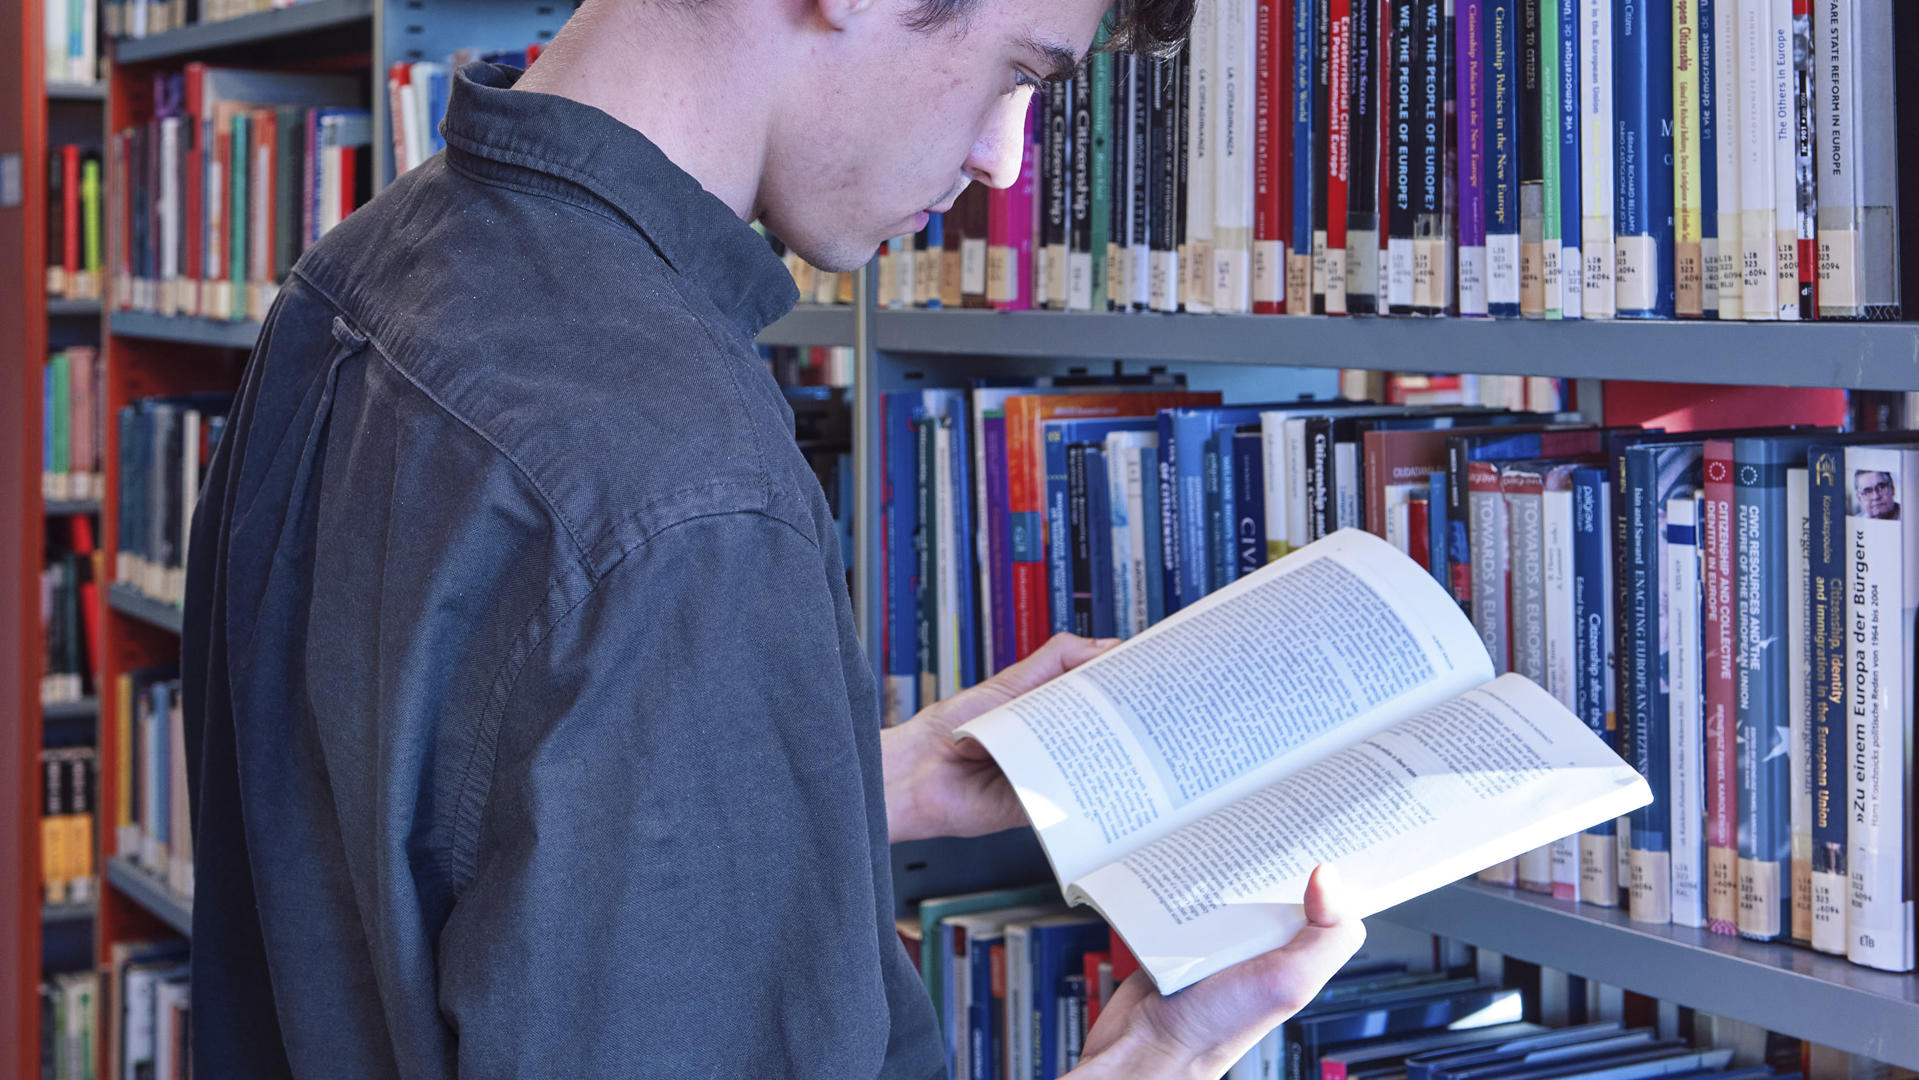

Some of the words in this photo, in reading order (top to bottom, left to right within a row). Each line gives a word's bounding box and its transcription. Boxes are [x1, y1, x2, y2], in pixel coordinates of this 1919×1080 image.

[1332, 22, 1341, 33] in
[1399, 5, 1410, 32] WE,
[1426, 4, 1437, 31] WE,
[1591, 8, 1601, 17] in
[1591, 20, 1601, 36] the
[1624, 5, 1635, 36] Citizens
[1700, 16, 1709, 28] de
[1258, 5, 1269, 77] CITIZENSHIP
[1322, 35, 1329, 44] in
[1468, 4, 1479, 58] Citizenship
[1494, 7, 1506, 70] Citizenship
[1525, 32, 1535, 45] TO
[1562, 24, 1571, 37] de
[1830, 28, 1841, 61] STATE
[1300, 45, 1308, 60] the
[1340, 16, 1350, 109] Extraterritorial
[1399, 36, 1410, 62] THE
[1426, 36, 1437, 62] THE
[1590, 39, 1601, 83] European
[1676, 27, 1692, 71] Citizenship
[1775, 29, 1787, 66] Europe
[1300, 63, 1309, 88] Arab
[1321, 62, 1330, 85] West
[1331, 36, 1341, 130] Postcommunist
[1469, 61, 1480, 95] Policies
[1525, 48, 1535, 90] CITIZENS
[1562, 40, 1574, 113] démocratique
[1700, 33, 1712, 106] démocratique
[1776, 69, 1786, 79] in
[1398, 66, 1410, 120] PEOPLE
[1425, 66, 1437, 120] PEOPLE
[1470, 98, 1480, 108] in
[1496, 74, 1507, 114] Policies
[1592, 86, 1601, 114] Union
[1776, 82, 1788, 118] Others
[1831, 65, 1842, 111] REFORM
[1226, 83, 1236, 157] CITTADINANZA
[1299, 91, 1308, 122] World
[1470, 110, 1480, 125] the
[1701, 111, 1710, 126] vie
[1832, 114, 1842, 126] IN
[1398, 124, 1409, 142] OF
[1425, 124, 1436, 142] OF
[1497, 118, 1507, 130] in
[1564, 115, 1573, 130] vie
[1619, 121, 1627, 144] DARIO
[1701, 128, 1710, 139] La
[1777, 122, 1788, 140] The
[1338, 113, 1349, 181] Citizenship
[1470, 128, 1479, 150] New
[1497, 133, 1507, 151] the
[1565, 134, 1573, 144] La
[1832, 130, 1843, 176] EUROPE
[1050, 115, 1065, 225] Citizenship
[1073, 109, 1090, 220] Citizenship
[1258, 118, 1269, 193] ORIENTALISM
[1329, 134, 1340, 176] Europe
[1470, 154, 1480, 187] Europe
[1497, 154, 1507, 180] New
[1619, 146, 1627, 194] CASTIGLIONE
[1398, 147, 1409, 210] EUROPE?
[1424, 147, 1436, 210] EUROPE?
[1627, 165, 1635, 197] RICHARD
[1495, 184, 1507, 224] Europe
[1744, 269, 1767, 277] .6094
[1314, 434, 1327, 509] Citizenship
[1583, 486, 1595, 533] palgrave
[1634, 488, 1645, 506] Isin
[1634, 508, 1645, 526] and
[1707, 501, 1717, 553] IDENTITY
[1739, 505, 1748, 552] FUTURE
[1749, 505, 1760, 537] CIVIC
[1822, 496, 1833, 564] Kostakopoulou
[1480, 497, 1496, 583] TOWARDS
[1526, 500, 1540, 583] TOWARDS
[1634, 529, 1646, 564] Saward
[1719, 501, 1730, 575] CITIZENSHIP
[1708, 557, 1717, 569] IN
[1740, 555, 1748, 570] OF
[1749, 540, 1760, 614] RESOURCES
[1853, 530, 1868, 605] Bürger«
[1485, 584, 1496, 597] A
[1527, 587, 1539, 600] A
[1708, 572, 1718, 621] EUROPE
[1720, 578, 1731, 603] AND
[1740, 575, 1748, 596] THE
[1816, 577, 1828, 600] and
[1871, 585, 1880, 607] 2004
[1635, 570, 1647, 638] ENACTING
[1828, 578, 1843, 650] Citizenship,
[1871, 609, 1880, 622] bis
[1720, 606, 1732, 680] COLLECTIVE
[1740, 601, 1749, 667] EUROPEAN
[1750, 617, 1761, 642] AND
[1815, 604, 1828, 682] immigration
[1853, 612, 1865, 643] der
[1871, 625, 1880, 646] 1964
[1588, 614, 1601, 676] Citizenship
[1750, 648, 1761, 671] THE
[1872, 649, 1880, 667] von
[1590, 678, 1602, 704] after
[1636, 641, 1648, 711] EUROPEAN
[1740, 670, 1749, 710] UNION
[1828, 654, 1843, 704] identity
[1854, 649, 1868, 716] Europa
[1871, 671, 1880, 699] Reden
[1817, 686, 1828, 698] in
[1592, 707, 1602, 727] the
[1817, 702, 1828, 722] the
[1871, 702, 1881, 747] politische
[1717, 751, 1726, 780] PAWEL
[1816, 726, 1829, 785] European
[1854, 724, 1865, 782] einem
[1871, 750, 1880, 800] Koschnicks
[1818, 790, 1829, 827] Union
[1854, 788, 1865, 822] »Zu
[1871, 802, 1880, 825] Hans
[1740, 876, 1753, 884] LIB
[1815, 886, 1828, 894] LIB
[1816, 896, 1829, 904] 323
[1816, 905, 1839, 914] .6094
